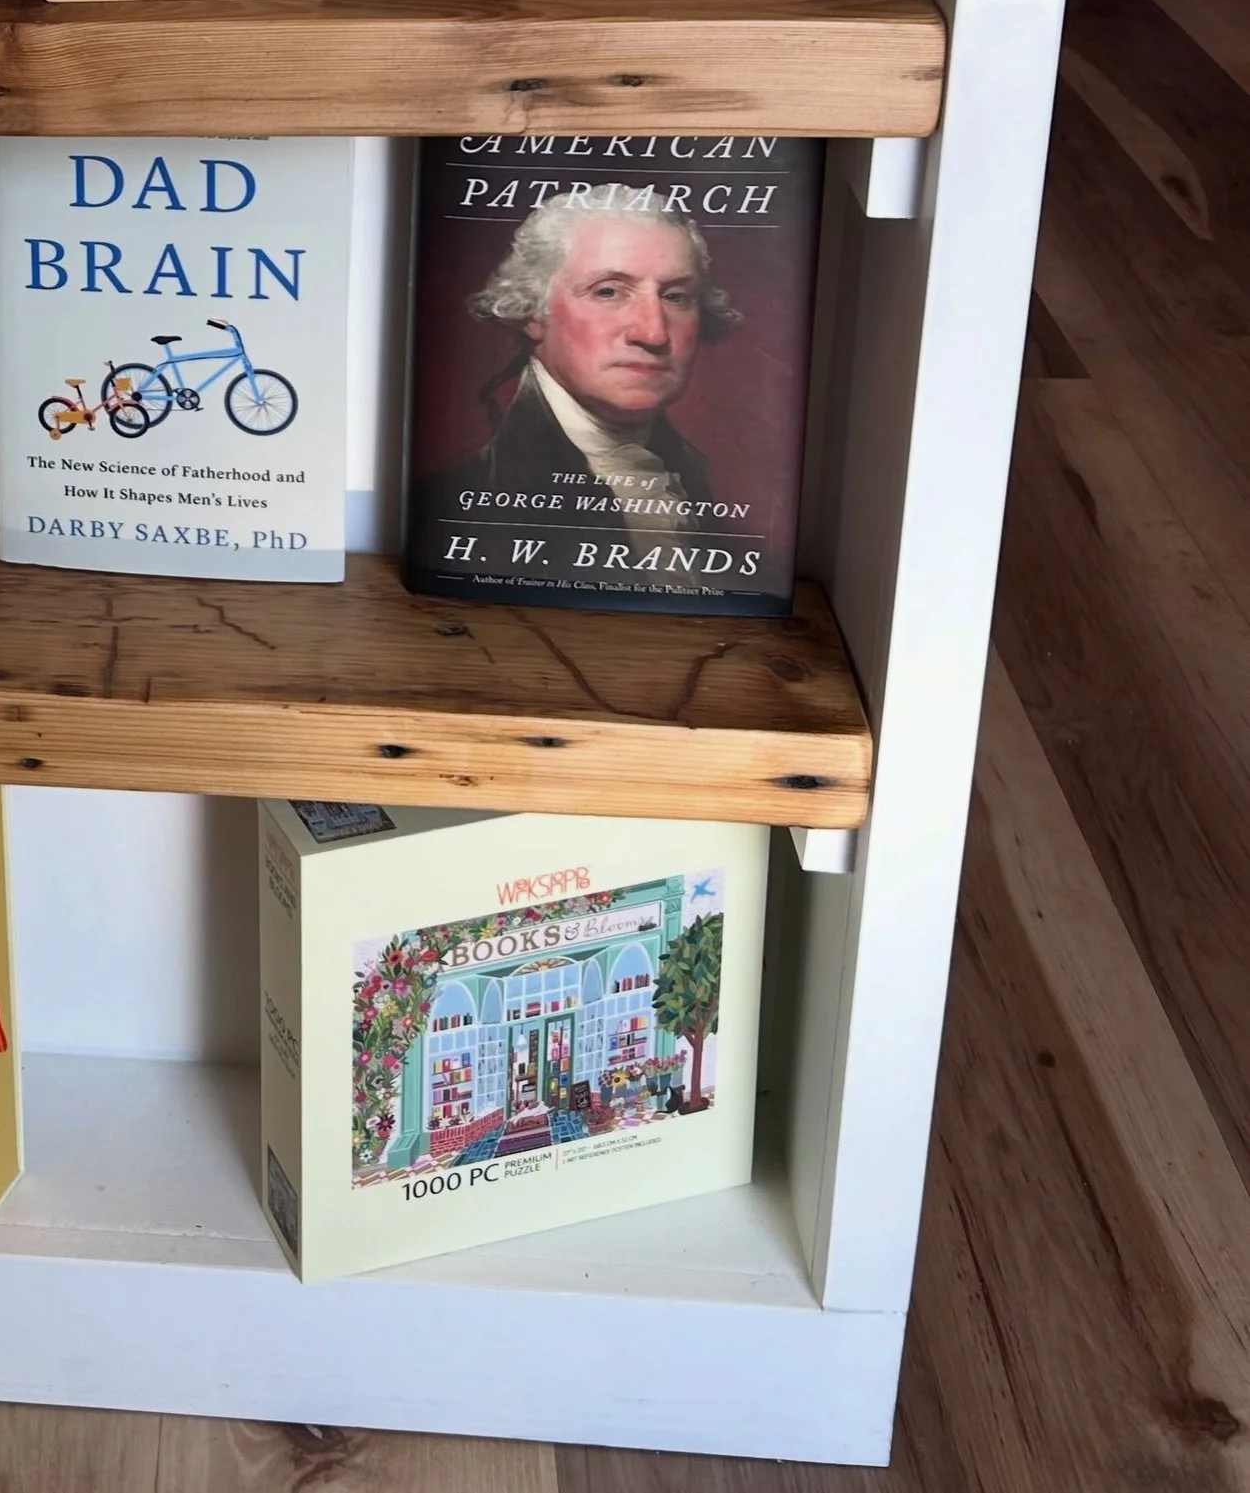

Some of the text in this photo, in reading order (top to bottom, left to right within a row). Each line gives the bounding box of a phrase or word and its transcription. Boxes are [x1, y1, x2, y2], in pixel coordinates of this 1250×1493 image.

[459, 136, 778, 159] AMERICAN
[68, 155, 256, 213] DAD
[460, 178, 779, 215] PATRIARCH
[24, 238, 307, 301] BRAIN
[26, 455, 305, 484] The New Science of Fatherhood and
[551, 472, 658, 490] THE LIFE of
[63, 484, 268, 510] How It Shapes Men's Lives
[459, 490, 750, 519] GEORGE WASHINGTON
[27, 516, 308, 552] DARBY SAXBE, PhD
[444, 536, 761, 577] H. W. BRANDS
[472, 574, 503, 585] Author
[505, 576, 515, 585] of
[633, 583, 647, 592] for
[648, 584, 662, 594] the
[701, 586, 725, 597] Prize
[451, 924, 561, 967] BOOKS
[564, 922, 580, 940] &
[401, 1151, 553, 1202] 1000 PC PREMIUM
[504, 1163, 541, 1179] PUZZLE
